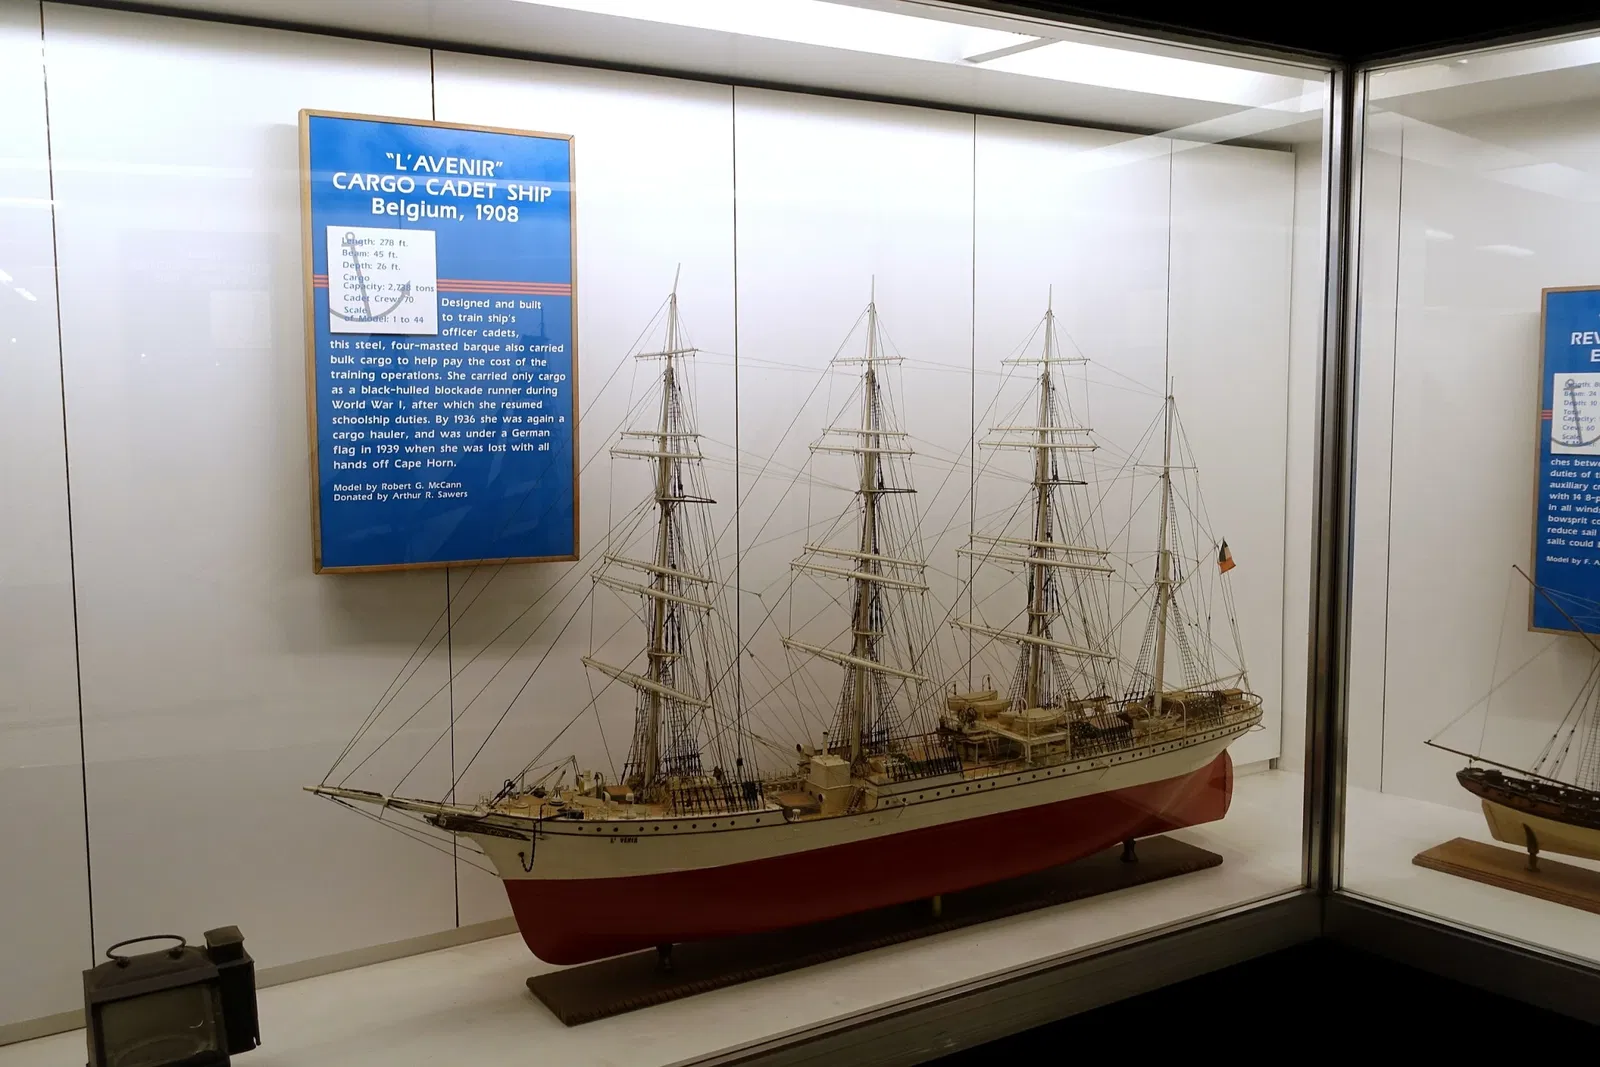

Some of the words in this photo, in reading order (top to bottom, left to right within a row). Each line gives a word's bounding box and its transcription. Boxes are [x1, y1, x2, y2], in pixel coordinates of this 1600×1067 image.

[333, 172, 414, 193] CARGO
[426, 179, 496, 199] CADET
[508, 184, 552, 202] SHIP
[372, 198, 464, 221] Belgium,
[476, 204, 519, 222] 1908
[342, 237, 375, 246] Length:
[343, 262, 372, 270] Depth:
[343, 274, 370, 283] Cargo
[344, 282, 384, 292] Capacity:
[442, 298, 489, 309] Designed
[495, 300, 514, 308] and
[520, 301, 541, 309] built
[442, 313, 453, 322] to
[458, 313, 482, 322] train
[488, 314, 516, 324] ship's
[442, 327, 477, 337] officer
[482, 328, 519, 338] cadets,
[330, 340, 350, 349] this
[356, 341, 385, 350] steel,
[392, 342, 458, 351] four-masted
[464, 343, 500, 352] barque
[505, 343, 524, 352] also
[530, 344, 563, 352] carried
[331, 356, 354, 364] bulk
[361, 357, 392, 366] cargo
[414, 356, 437, 367] help
[443, 358, 462, 368] pay
[468, 357, 484, 366] the
[515, 358, 526, 366] of
[531, 358, 546, 366] the
[331, 371, 375, 380] training
[381, 371, 442, 381] operations.
[448, 372, 465, 380] She
[471, 372, 506, 380] carried
[512, 372, 533, 382] only
[539, 373, 565, 382] cargo
[361, 385, 429, 395] black-hulled
[435, 386, 482, 395] blockade
[526, 387, 558, 396] during
[332, 401, 365, 409] World
[371, 401, 393, 409] War
[399, 401, 406, 410] I,
[412, 401, 438, 409] after
[444, 401, 474, 409] which
[479, 401, 496, 409] she
[501, 401, 542, 409] resumed
[333, 415, 390, 426] schoolship
[395, 415, 430, 424] duties.
[436, 415, 449, 425] By
[454, 415, 475, 424] 1936
[480, 415, 497, 424] she
[527, 415, 554, 425] again
[333, 431, 364, 441] cargo
[370, 430, 409, 439] hauler,
[414, 430, 435, 439] and
[466, 430, 496, 438] under
[512, 429, 550, 438] German
[333, 445, 356, 456] flag
[361, 445, 371, 454] in
[376, 445, 399, 454] 1939
[405, 444, 435, 453] when
[440, 444, 458, 453] she
[488, 444, 506, 452] lost
[512, 443, 533, 452] with
[538, 443, 550, 451] all
[334, 460, 367, 470] hands
[373, 460, 389, 469] off
[394, 459, 421, 469] Cape
[427, 459, 456, 468] Horn.
[366, 483, 377, 492] by
[1550, 482, 1588, 491] auxiliary
[334, 493, 372, 501] Donated
[377, 493, 388, 502] by
[392, 492, 421, 500] Arthur
[438, 490, 468, 498] Sawers
[1548, 515, 1587, 525] bowsprit
